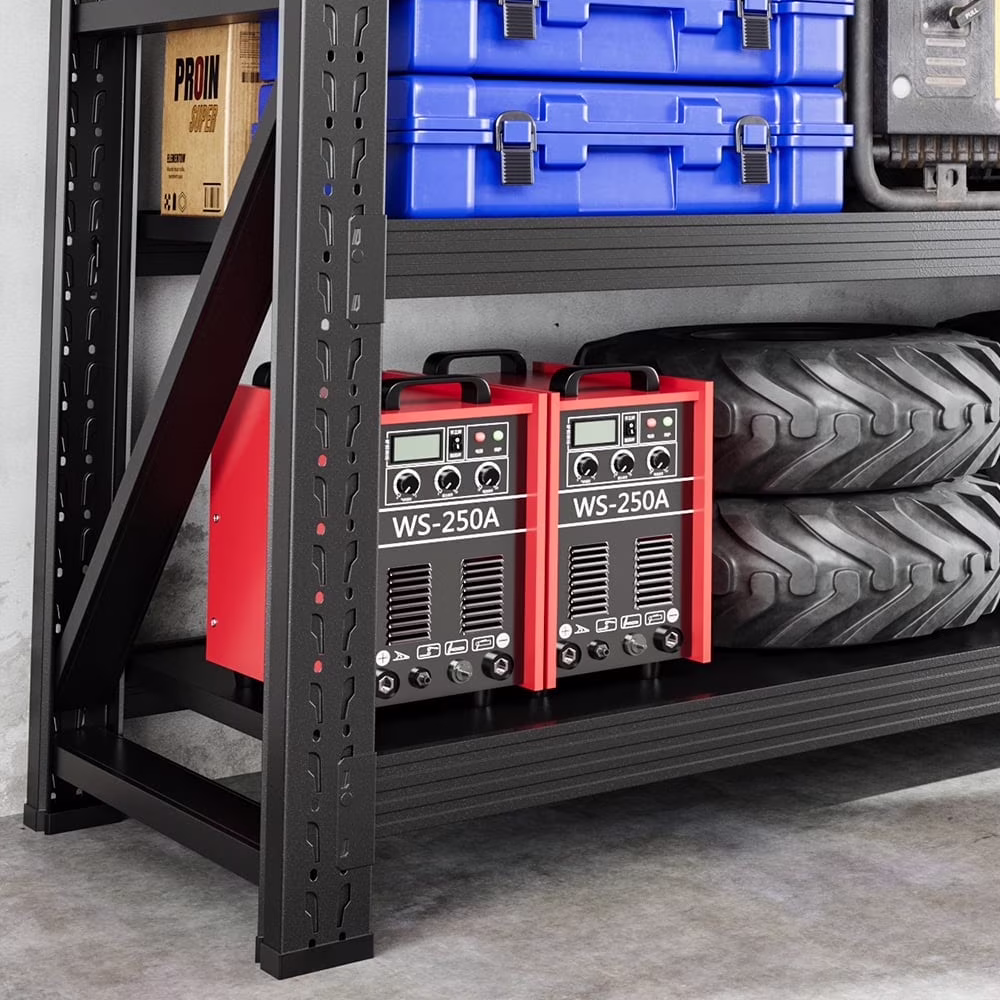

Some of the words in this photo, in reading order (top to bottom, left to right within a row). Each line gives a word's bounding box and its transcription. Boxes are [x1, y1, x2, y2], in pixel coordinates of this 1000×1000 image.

[174, 54, 220, 101] PROIN
[188, 104, 219, 133] SUPER
[573, 488, 670, 518] WS-250A
[392, 507, 501, 538] WS-250A
